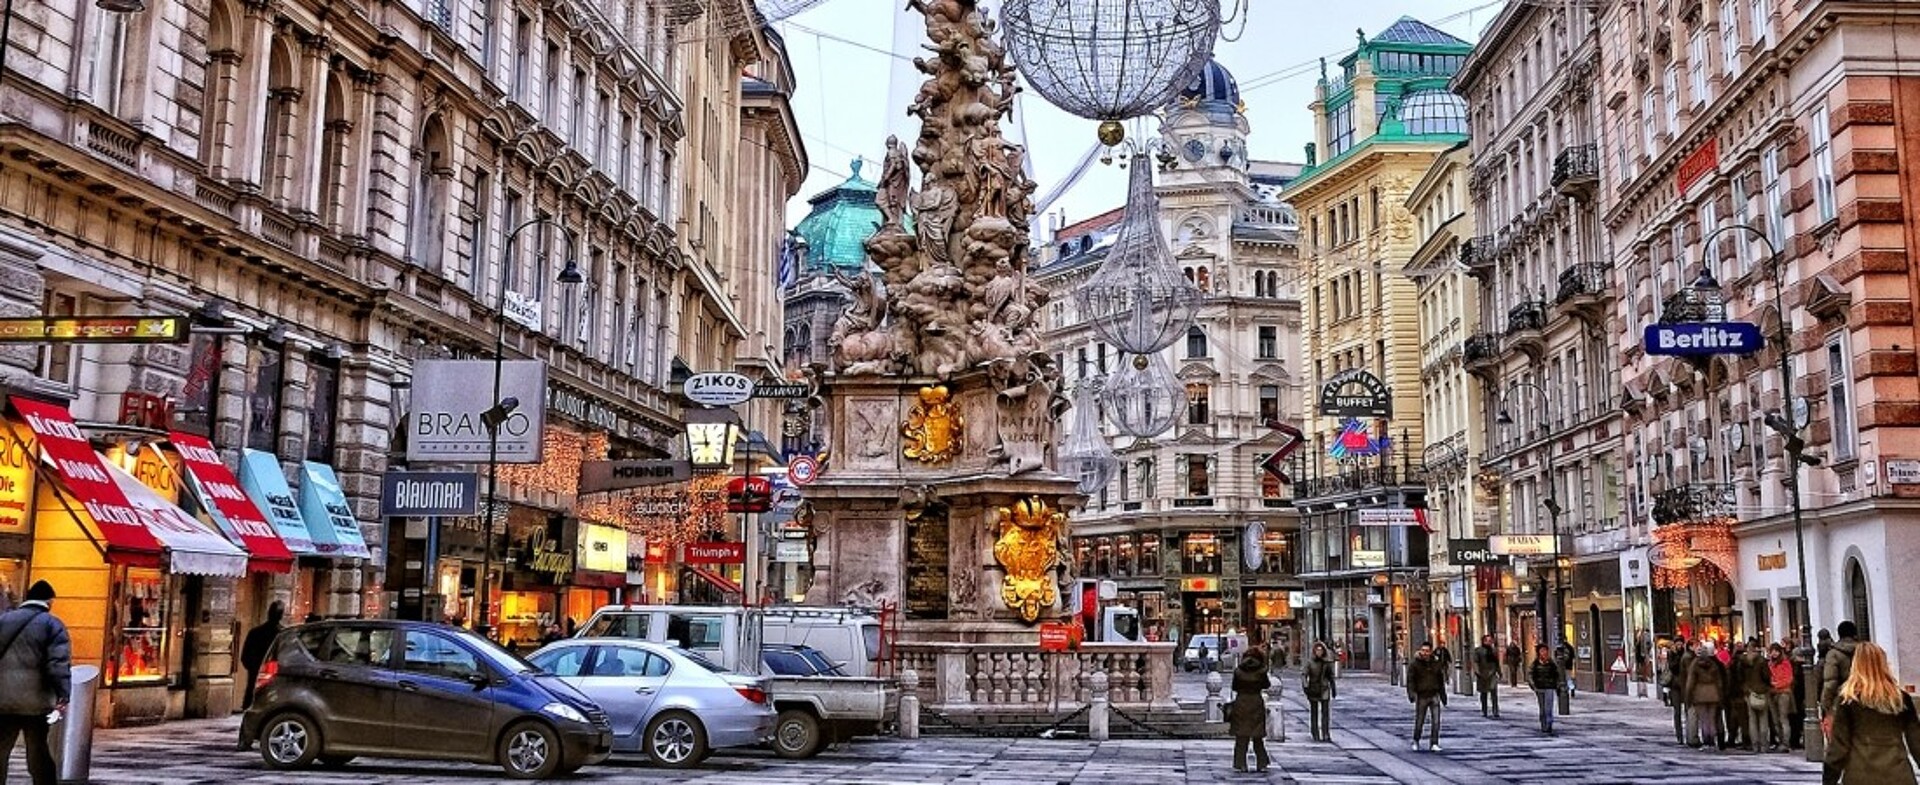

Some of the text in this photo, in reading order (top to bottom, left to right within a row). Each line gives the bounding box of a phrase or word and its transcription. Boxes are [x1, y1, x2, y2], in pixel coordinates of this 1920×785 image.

[1659, 326, 1743, 348] Berlitz
[692, 374, 748, 389] ZIKOS
[1336, 397, 1374, 407] BUFFET
[58, 458, 109, 484] BOOKS
[690, 547, 731, 559] Triumph
